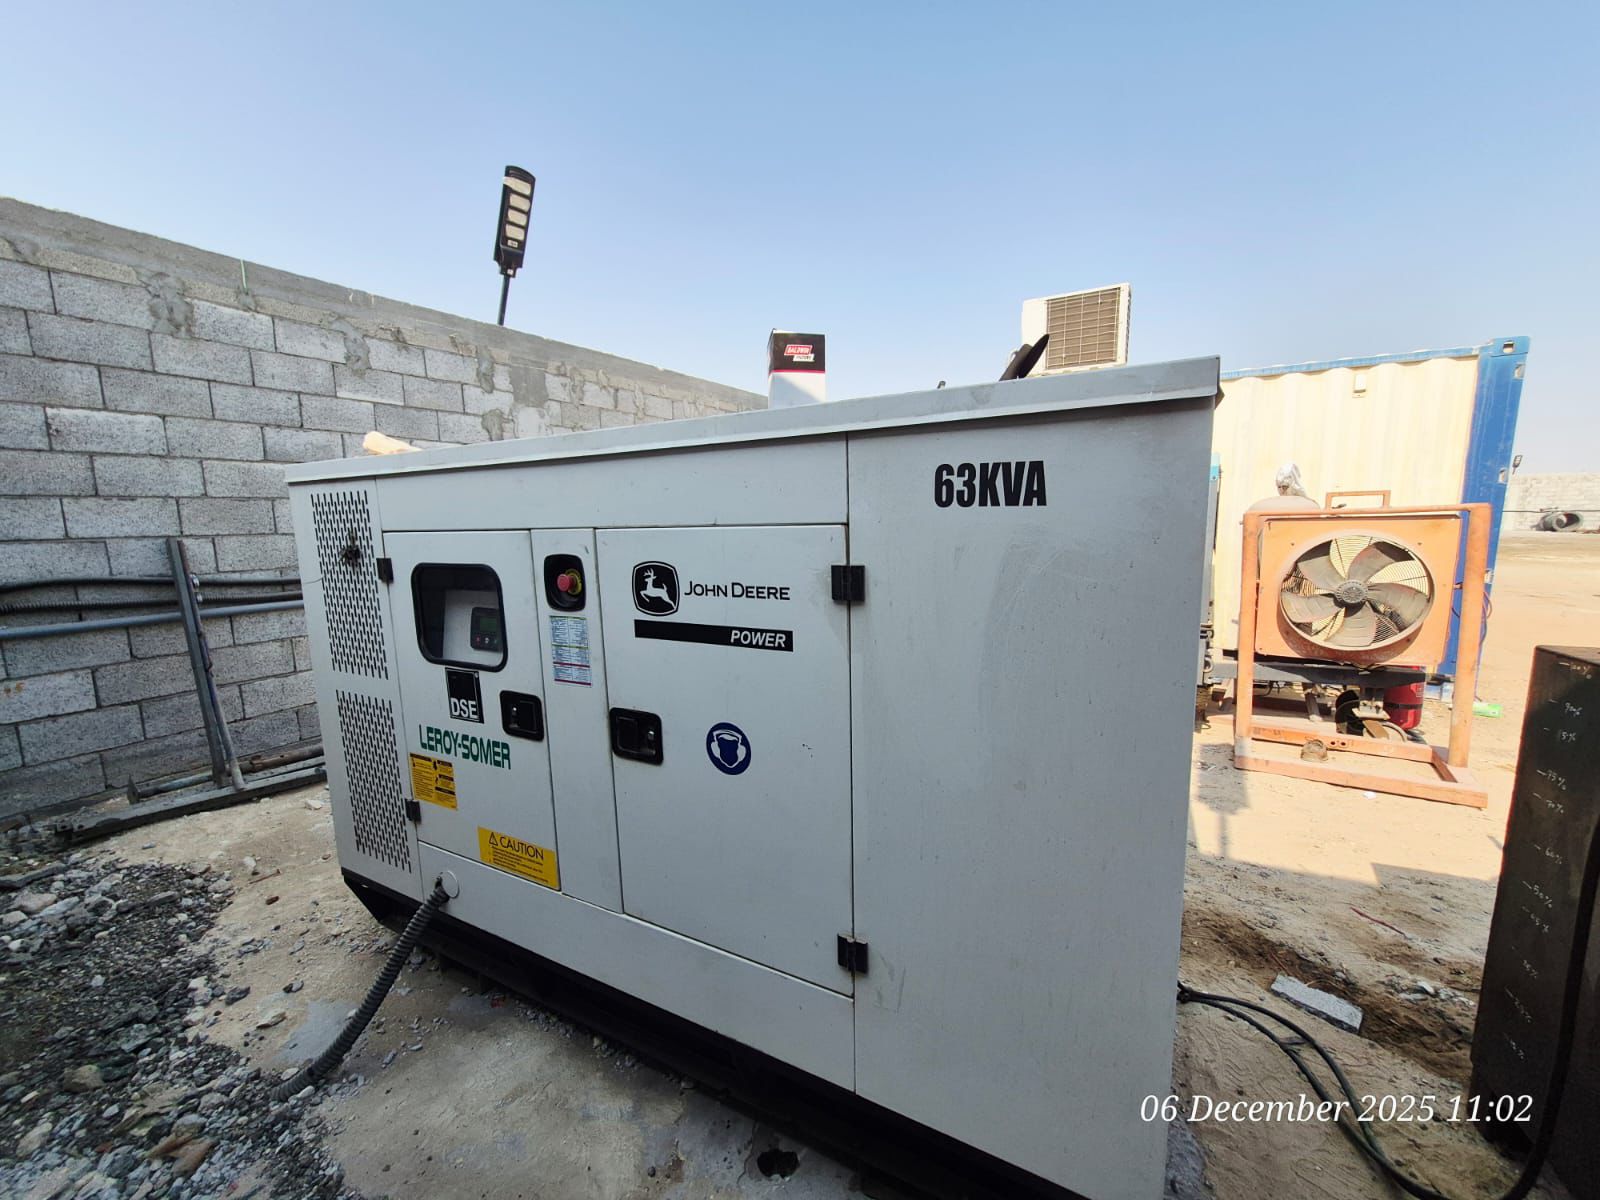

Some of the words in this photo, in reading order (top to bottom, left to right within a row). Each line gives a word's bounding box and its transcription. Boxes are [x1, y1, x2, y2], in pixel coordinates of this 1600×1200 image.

[934, 460, 1047, 508] 63KVA
[684, 581, 728, 597] JOHN
[731, 582, 790, 600] DEERE
[730, 630, 786, 648] POWER
[450, 697, 478, 718] DSE
[418, 724, 511, 770] LEROY-SOMER
[499, 836, 544, 861] CAUTION
